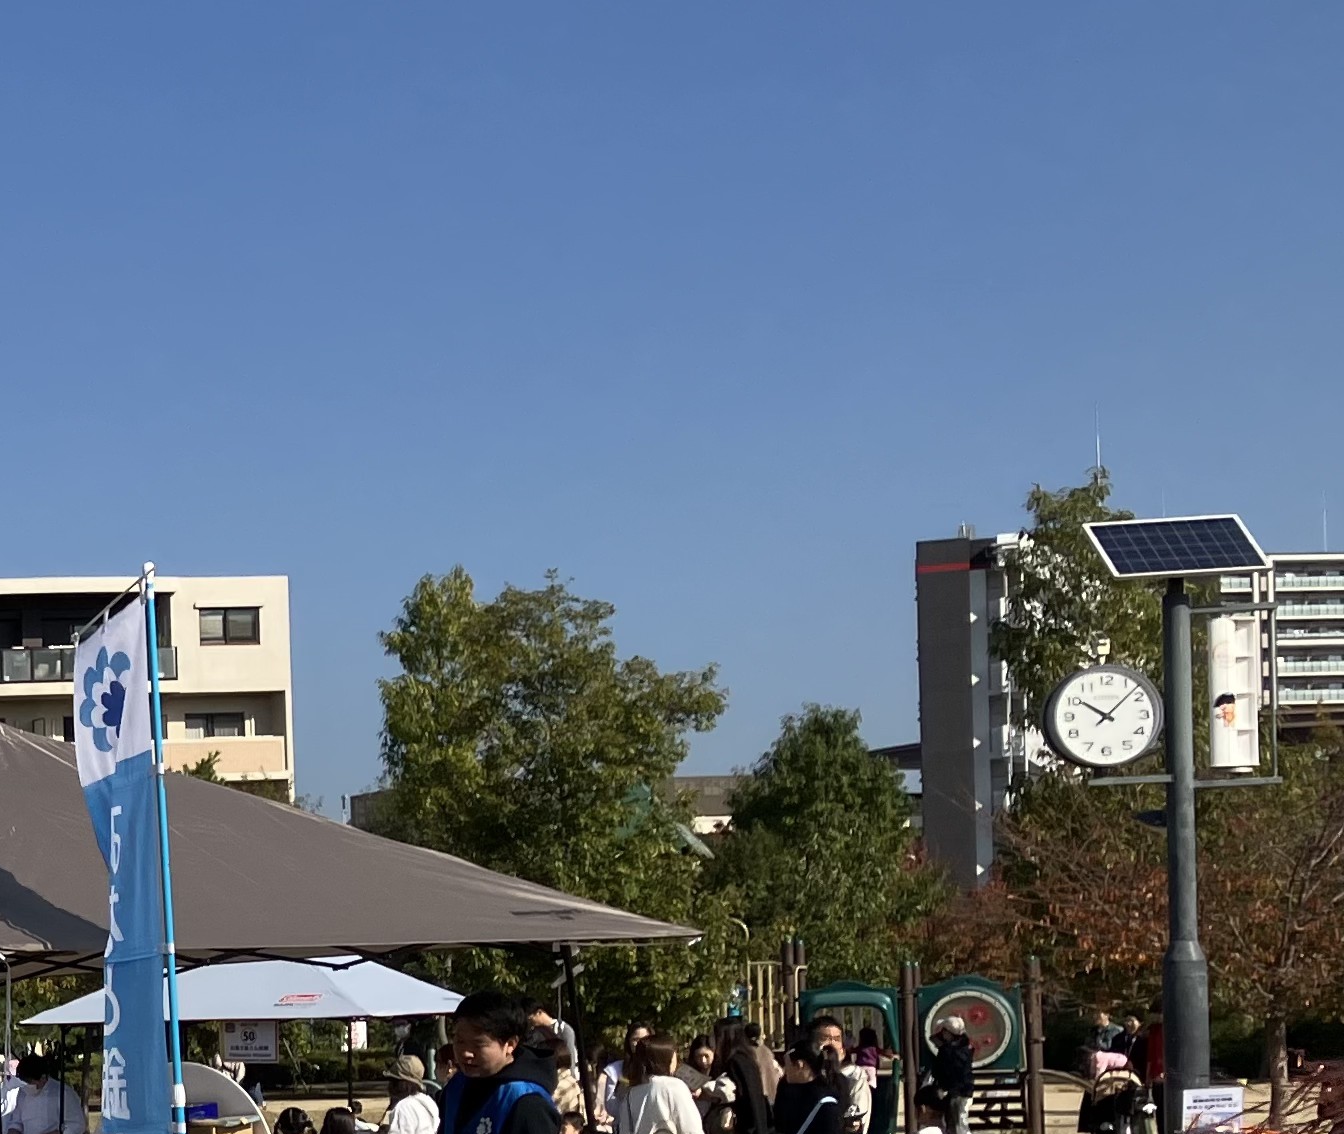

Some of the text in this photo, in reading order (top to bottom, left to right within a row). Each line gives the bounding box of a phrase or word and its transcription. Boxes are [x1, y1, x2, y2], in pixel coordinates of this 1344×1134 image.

[1100, 676, 1114, 686] 12
[1081, 683, 1093, 693] 11
[1068, 697, 1081, 706] 10
[1134, 692, 1144, 702] 2
[1064, 712, 1075, 722] 9
[1139, 709, 1150, 720] 3
[1069, 729, 1079, 738] 8
[1133, 726, 1145, 735] 4
[1081, 742, 1094, 752] 7
[1122, 740, 1133, 750] 5
[1101, 746, 1112, 756] 6
[243, 1031, 256, 1042] 50
